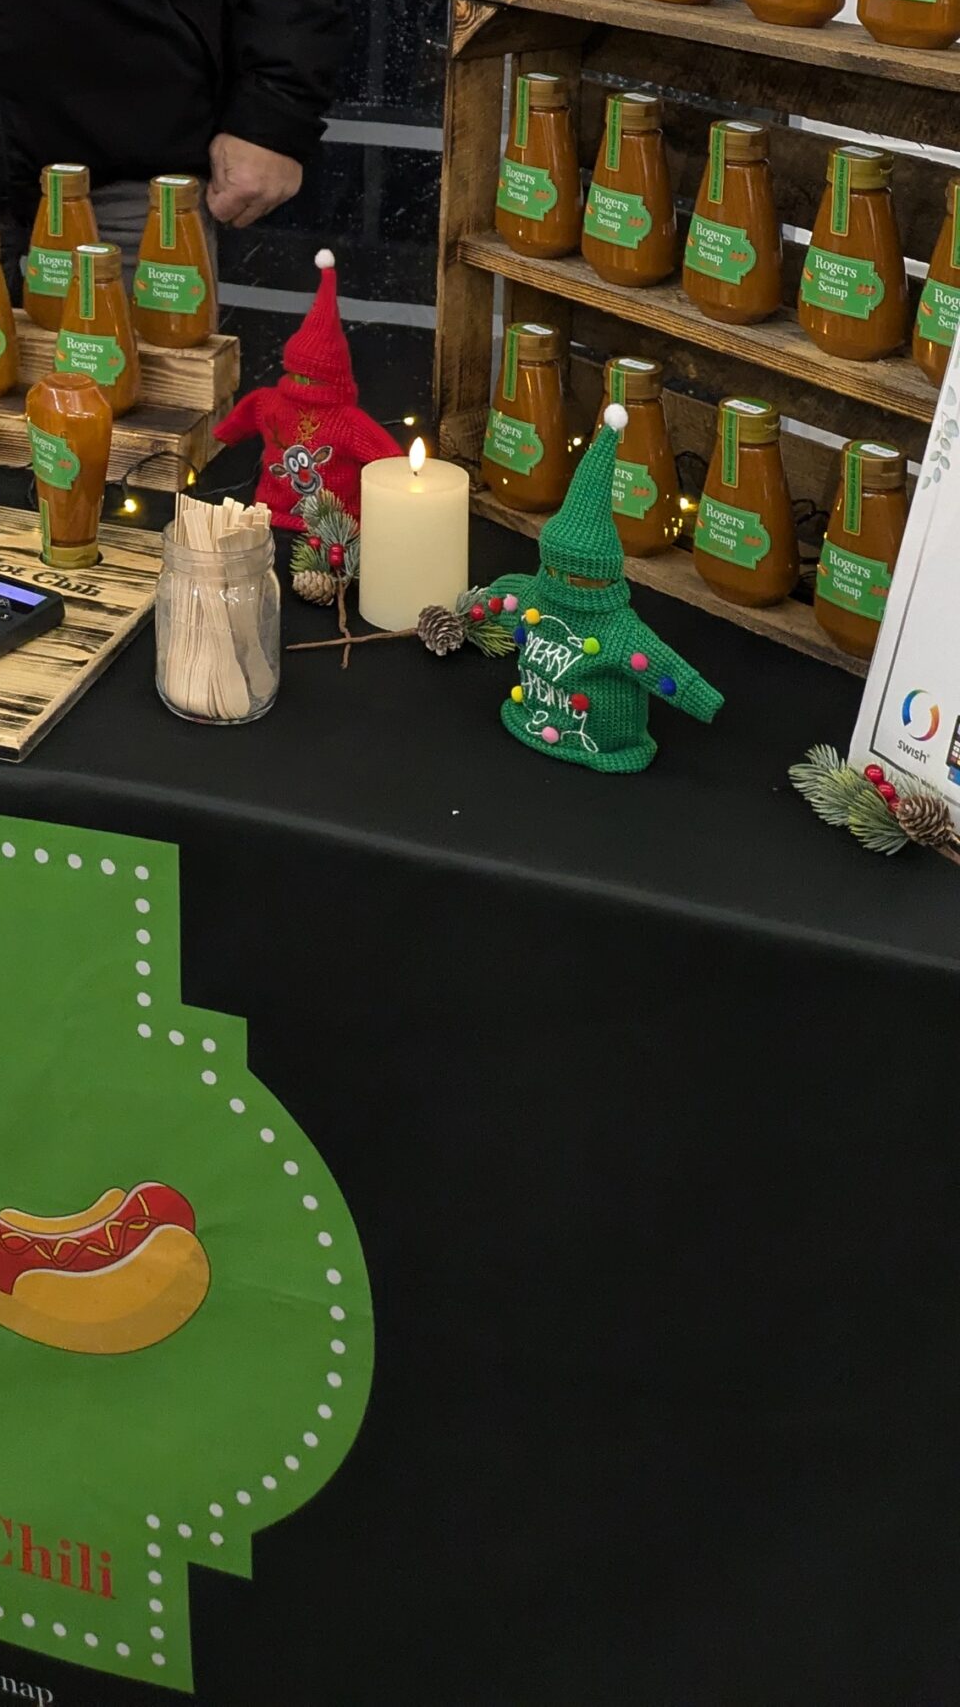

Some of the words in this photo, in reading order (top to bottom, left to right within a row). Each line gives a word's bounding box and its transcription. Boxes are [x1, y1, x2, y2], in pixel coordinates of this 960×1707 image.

[505, 165, 536, 185] Rogers
[507, 187, 528, 204] Senap
[594, 191, 628, 212] Rogers
[596, 214, 620, 232] Senap
[696, 222, 731, 245] Rogers
[39, 254, 72, 268] Rogers
[698, 246, 722, 265] Senap
[148, 267, 186, 282] Rogers
[815, 254, 857, 278] Rogers
[43, 274, 69, 286] Senap
[818, 280, 848, 300] Senap
[152, 288, 179, 301] Senap
[934, 288, 960, 311] Rog
[66, 337, 103, 352] Rogers
[71, 358, 97, 372] Senap
[492, 414, 522, 439] Rogers
[706, 502, 744, 530] Rogers
[709, 528, 736, 550] Senap
[829, 550, 870, 578] Rogers
[832, 577, 861, 599] Senap
[897, 740, 927, 764] swish
